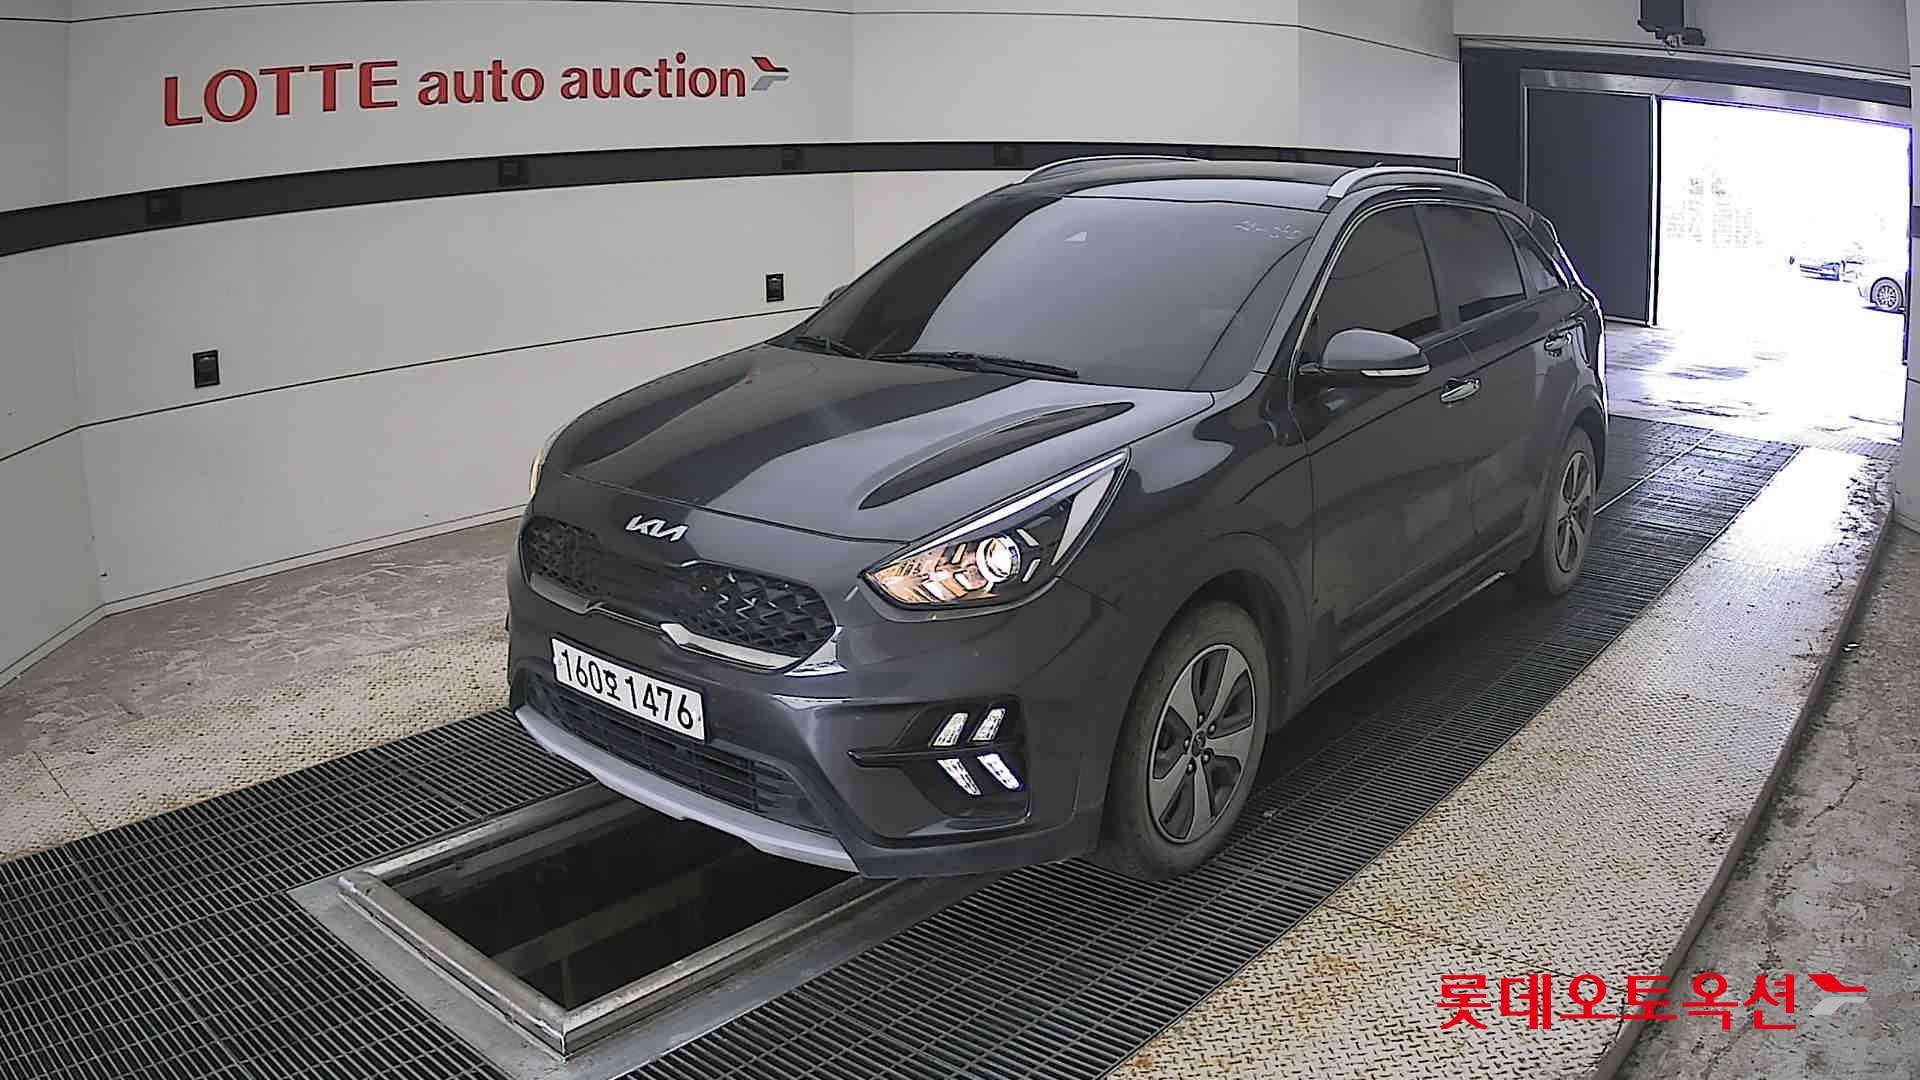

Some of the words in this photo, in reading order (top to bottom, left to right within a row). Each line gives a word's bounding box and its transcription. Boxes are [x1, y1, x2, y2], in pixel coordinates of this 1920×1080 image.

[163, 59, 399, 127] LOTTE
[417, 59, 545, 106] auto
[560, 51, 747, 99] auction
[625, 515, 688, 541] KIA
